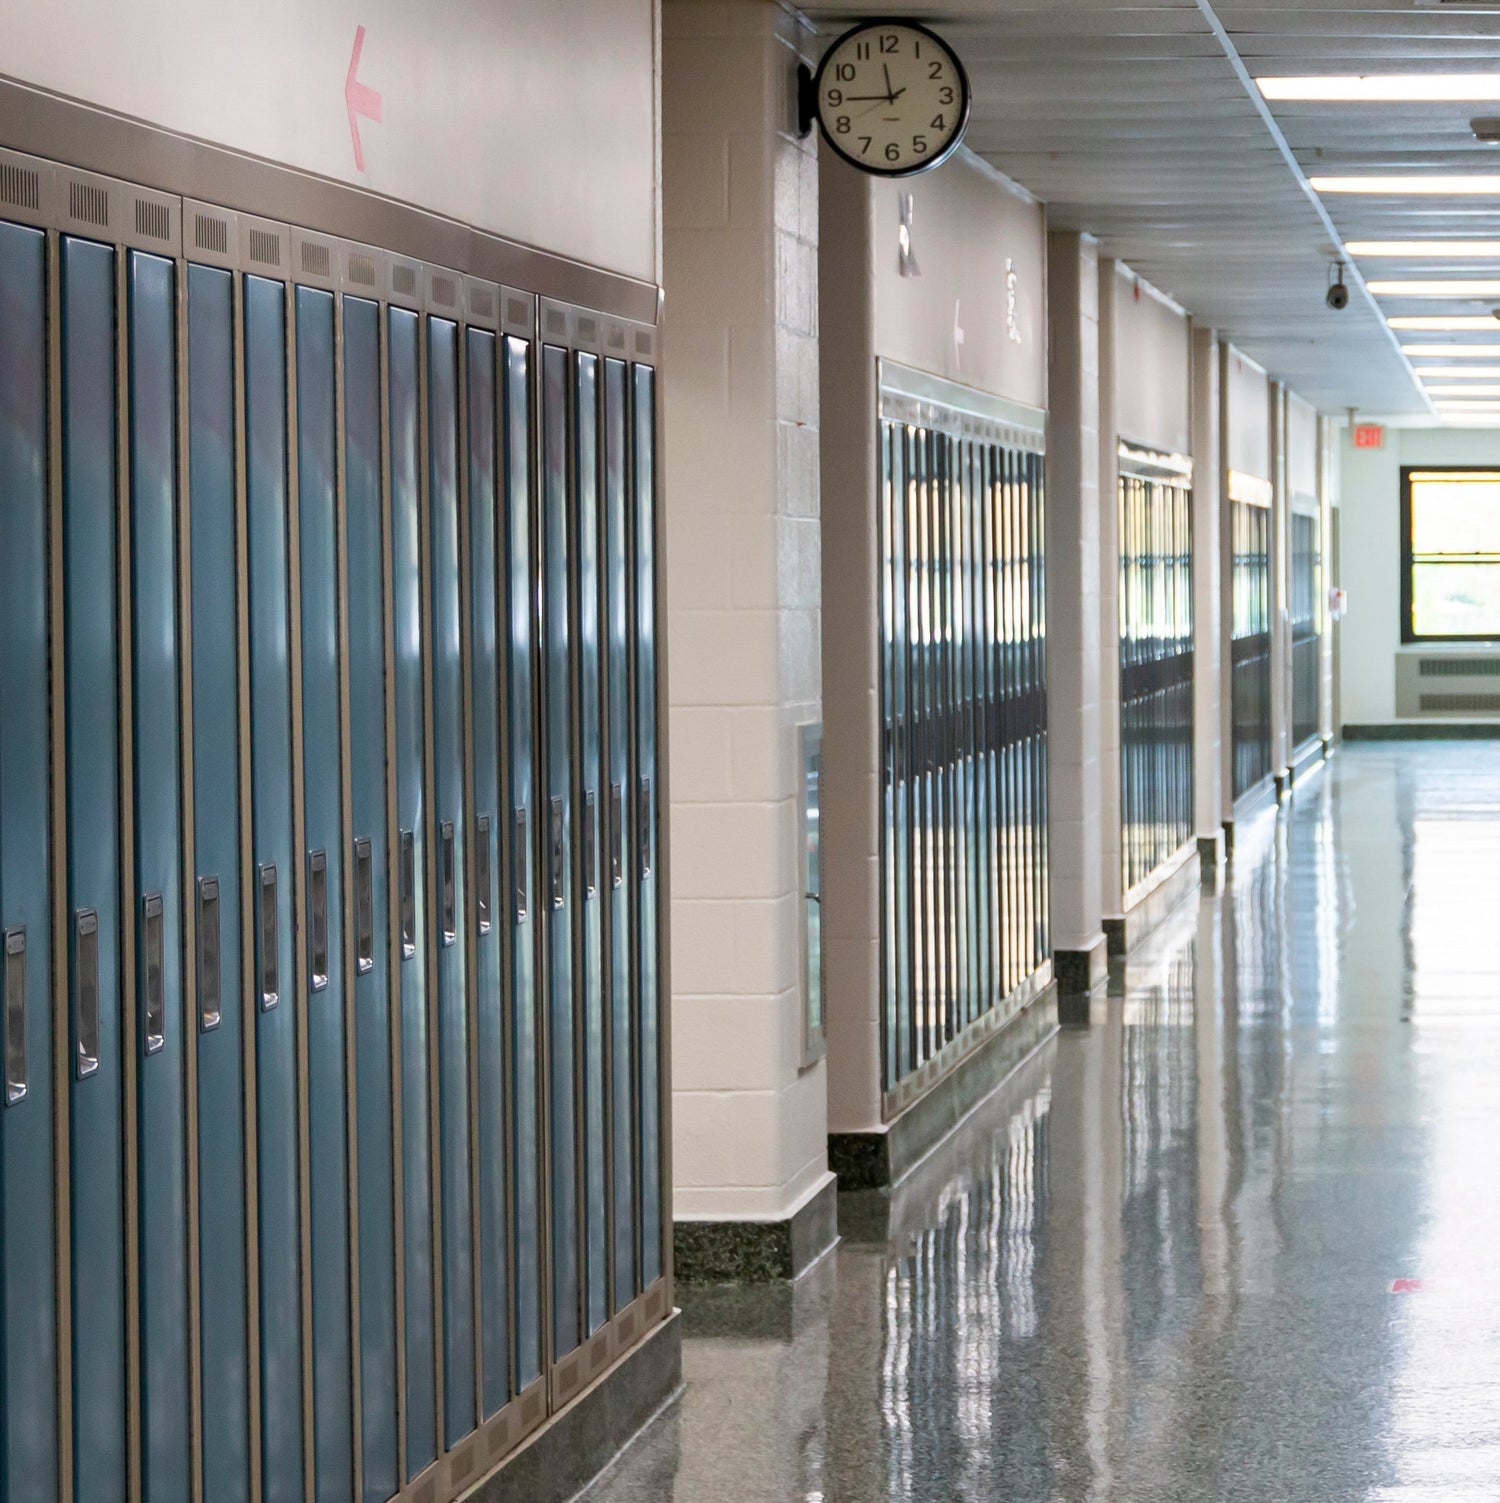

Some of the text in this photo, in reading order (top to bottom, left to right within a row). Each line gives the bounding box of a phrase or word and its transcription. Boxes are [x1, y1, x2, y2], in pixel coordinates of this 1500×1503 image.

[857, 42, 870, 60] 11
[879, 35, 899, 53] 12
[836, 63, 856, 81] 10
[928, 61, 943, 80] 2
[827, 89, 843, 107] 9
[939, 87, 954, 105] 3
[836, 116, 851, 134] 8
[930, 113, 946, 131] 4
[857, 136, 872, 155] 7
[884, 142, 900, 161] 6
[912, 135, 927, 153] 5
[1356, 426, 1382, 447] EXIT
